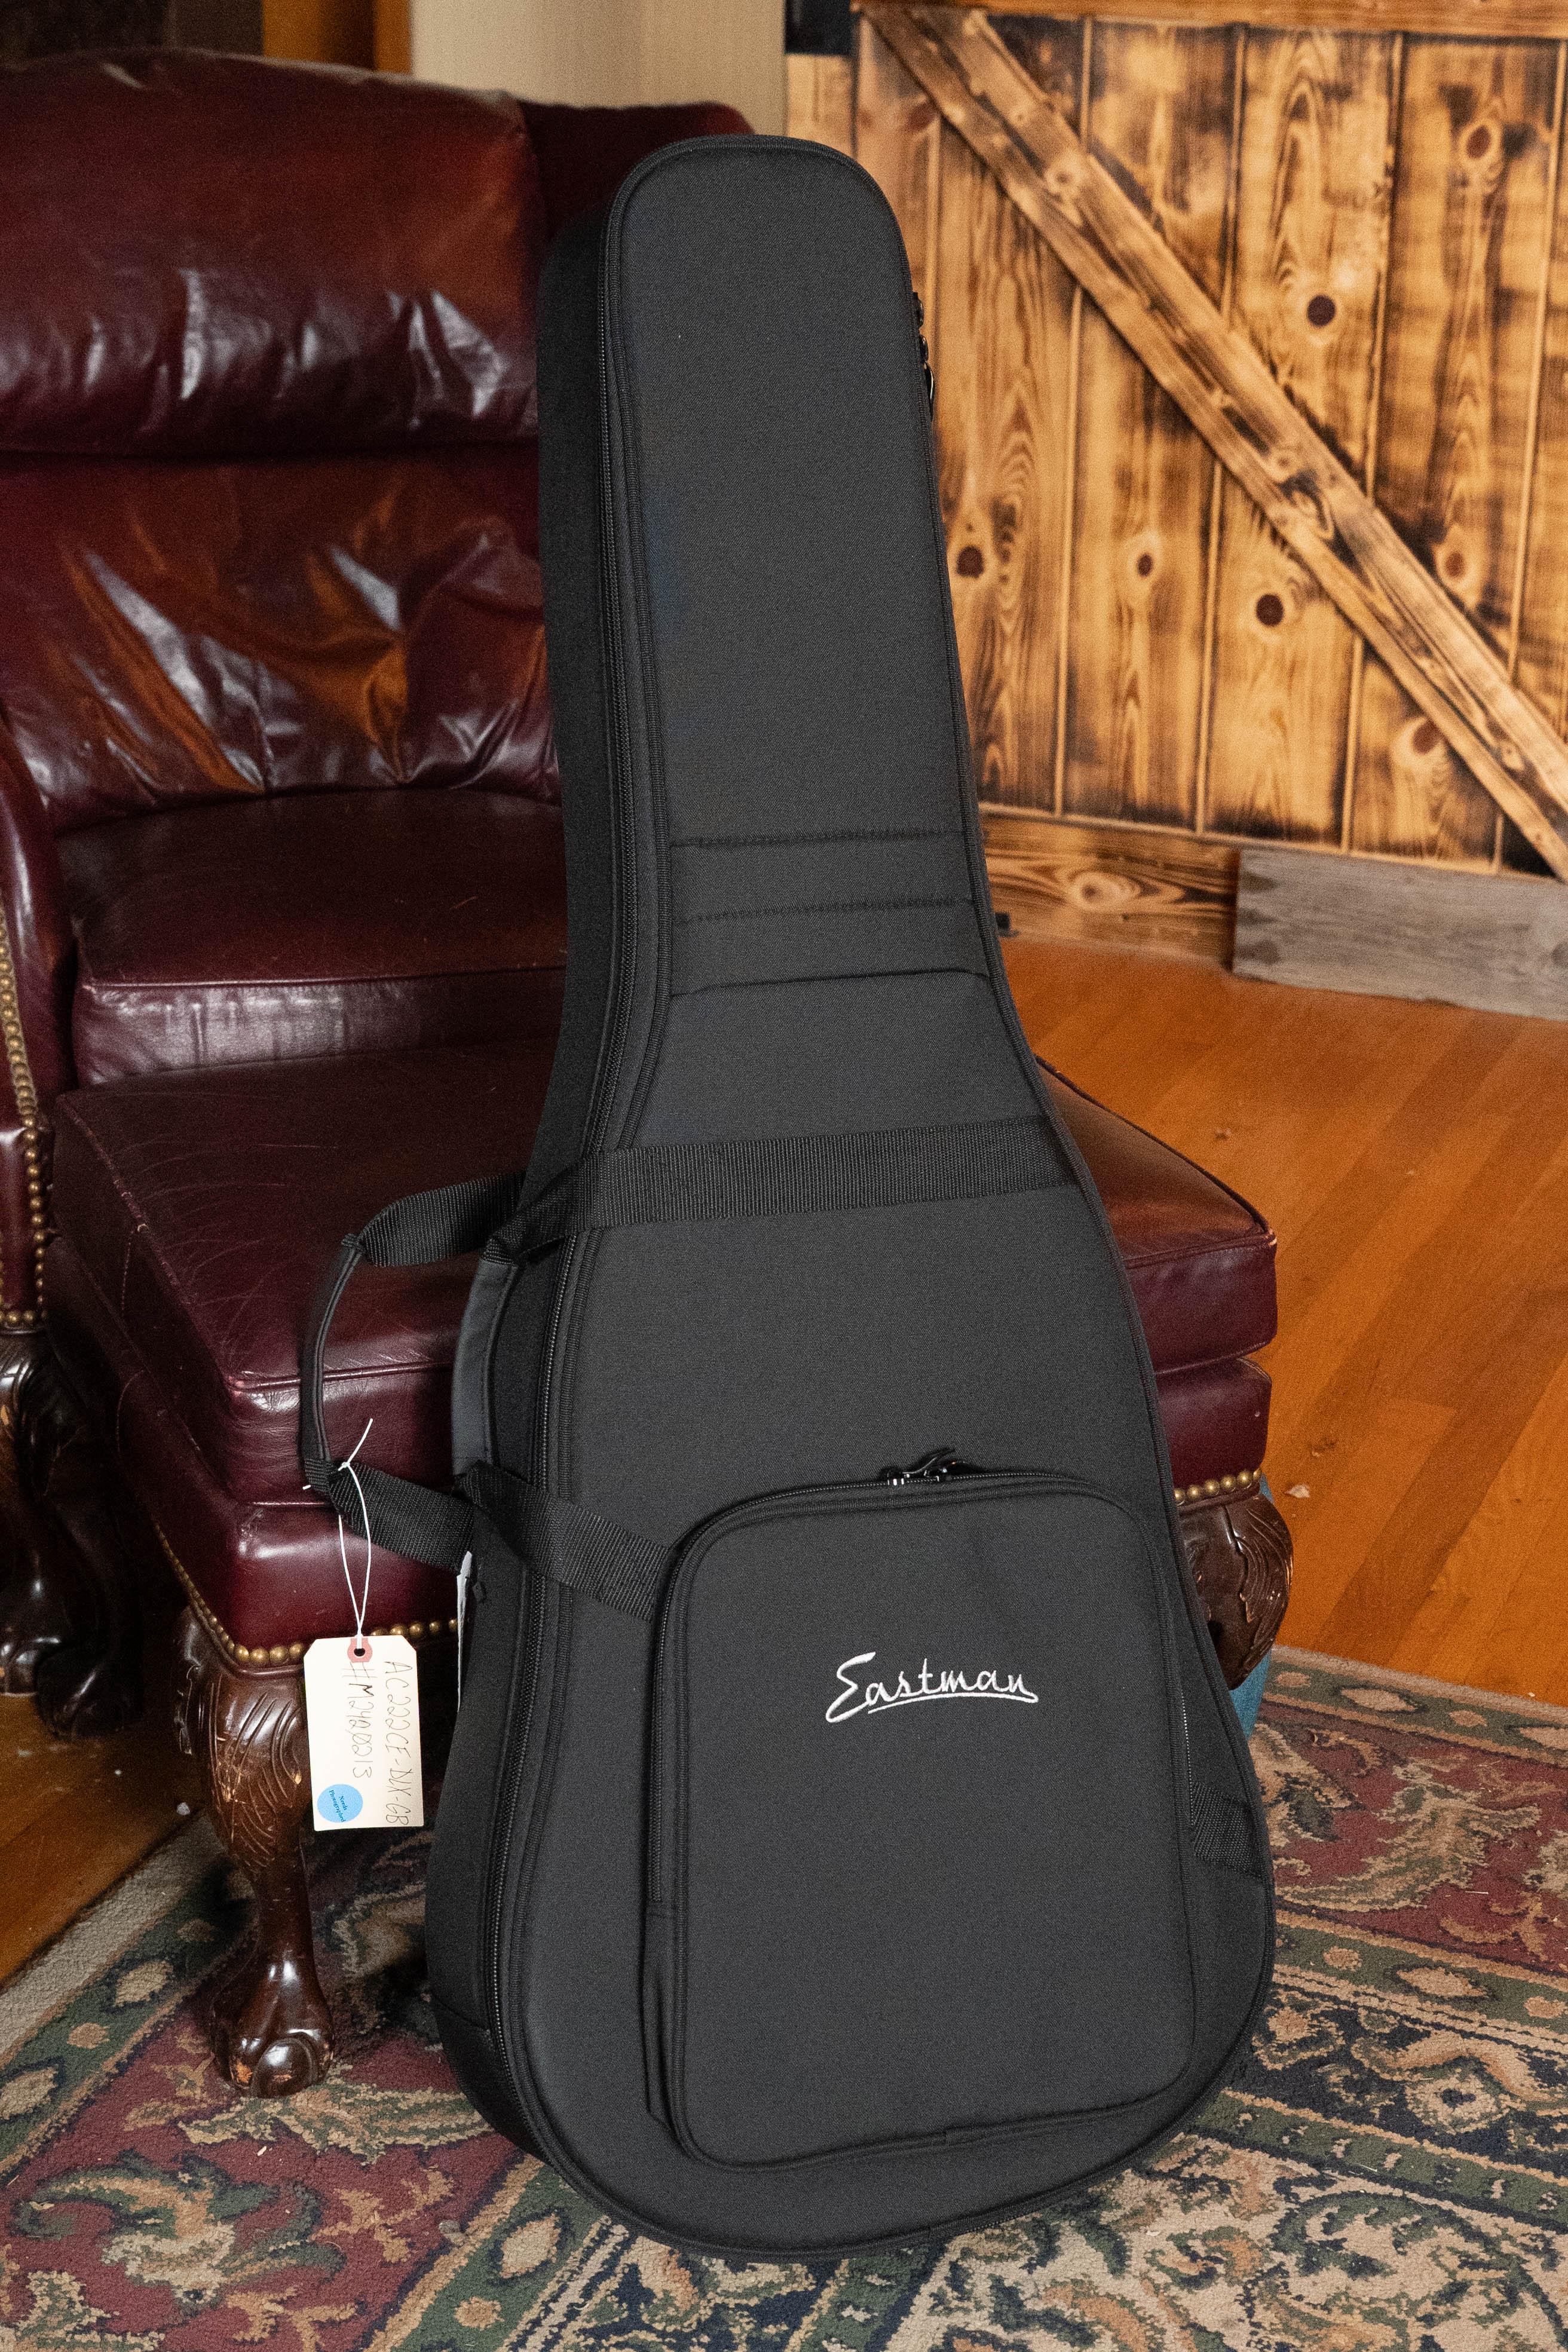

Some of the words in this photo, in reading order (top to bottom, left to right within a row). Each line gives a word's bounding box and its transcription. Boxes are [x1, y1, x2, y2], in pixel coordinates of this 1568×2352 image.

[825, 1651, 1039, 1723] Eastman
[329, 1789, 345, 1823] Photographed
[339, 1795, 348, 1811] Needs
